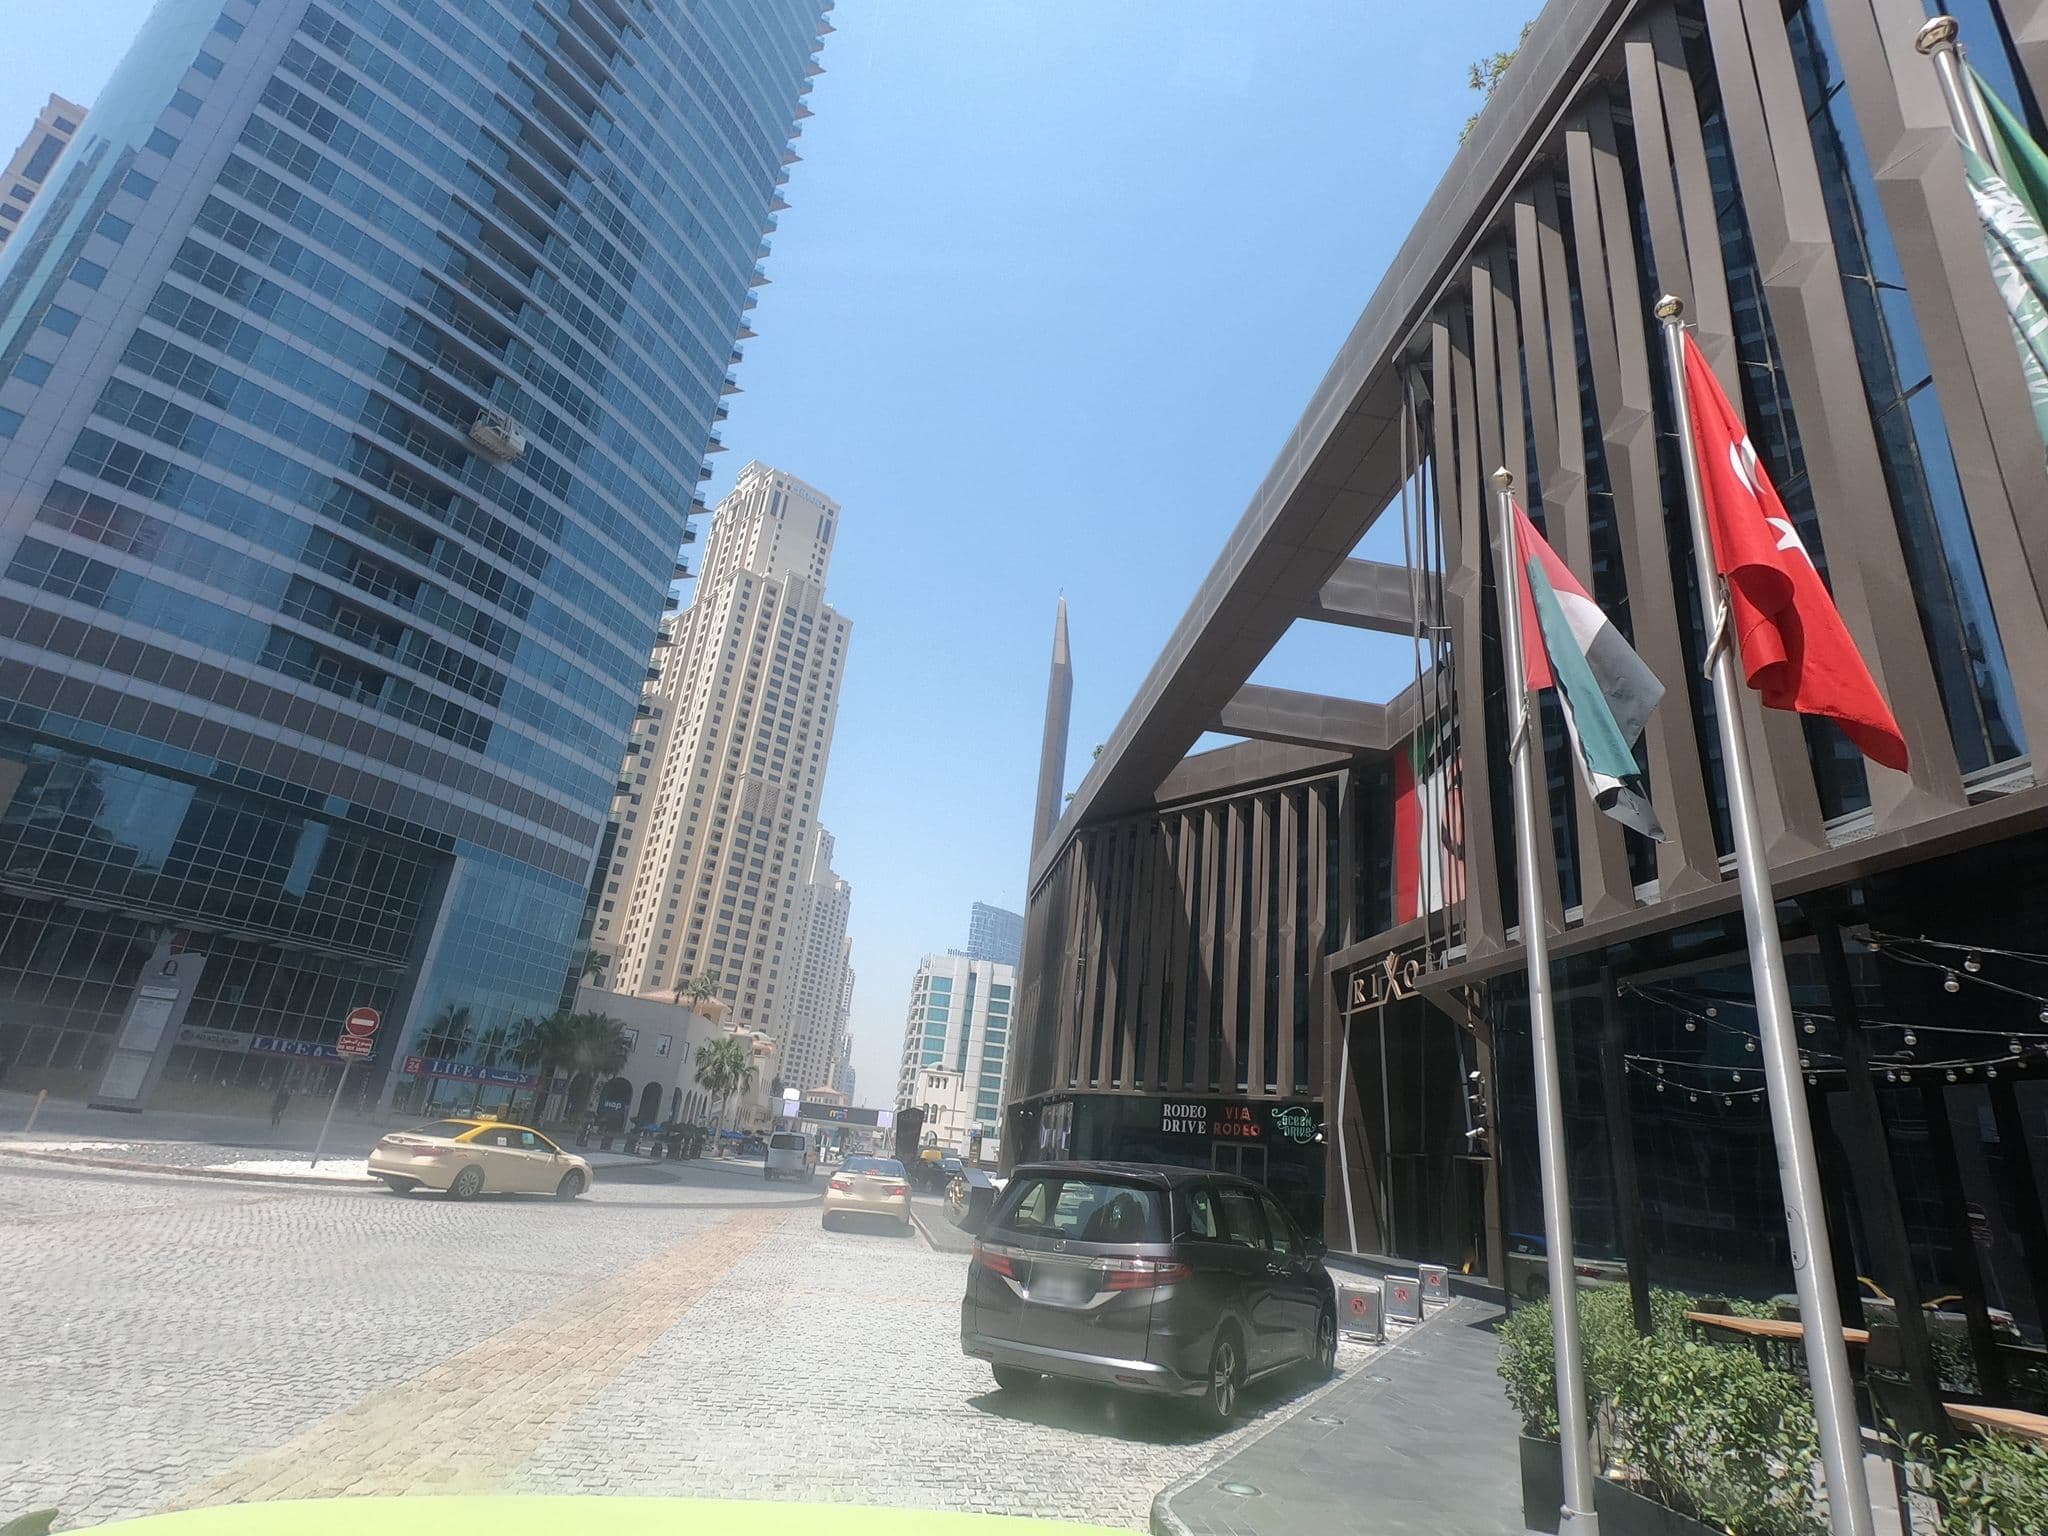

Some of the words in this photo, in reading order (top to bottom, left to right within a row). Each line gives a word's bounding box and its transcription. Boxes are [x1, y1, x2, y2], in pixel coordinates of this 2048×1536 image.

[1353, 951, 1428, 1005] RIXO
[253, 1037, 310, 1057] LIFE
[432, 1061, 474, 1077] LIFE
[1163, 1103, 1207, 1119] RODEO
[1225, 1106, 1251, 1121] VIA
[1162, 1118, 1206, 1134] DRIVE
[1213, 1122, 1260, 1137] RODEO
